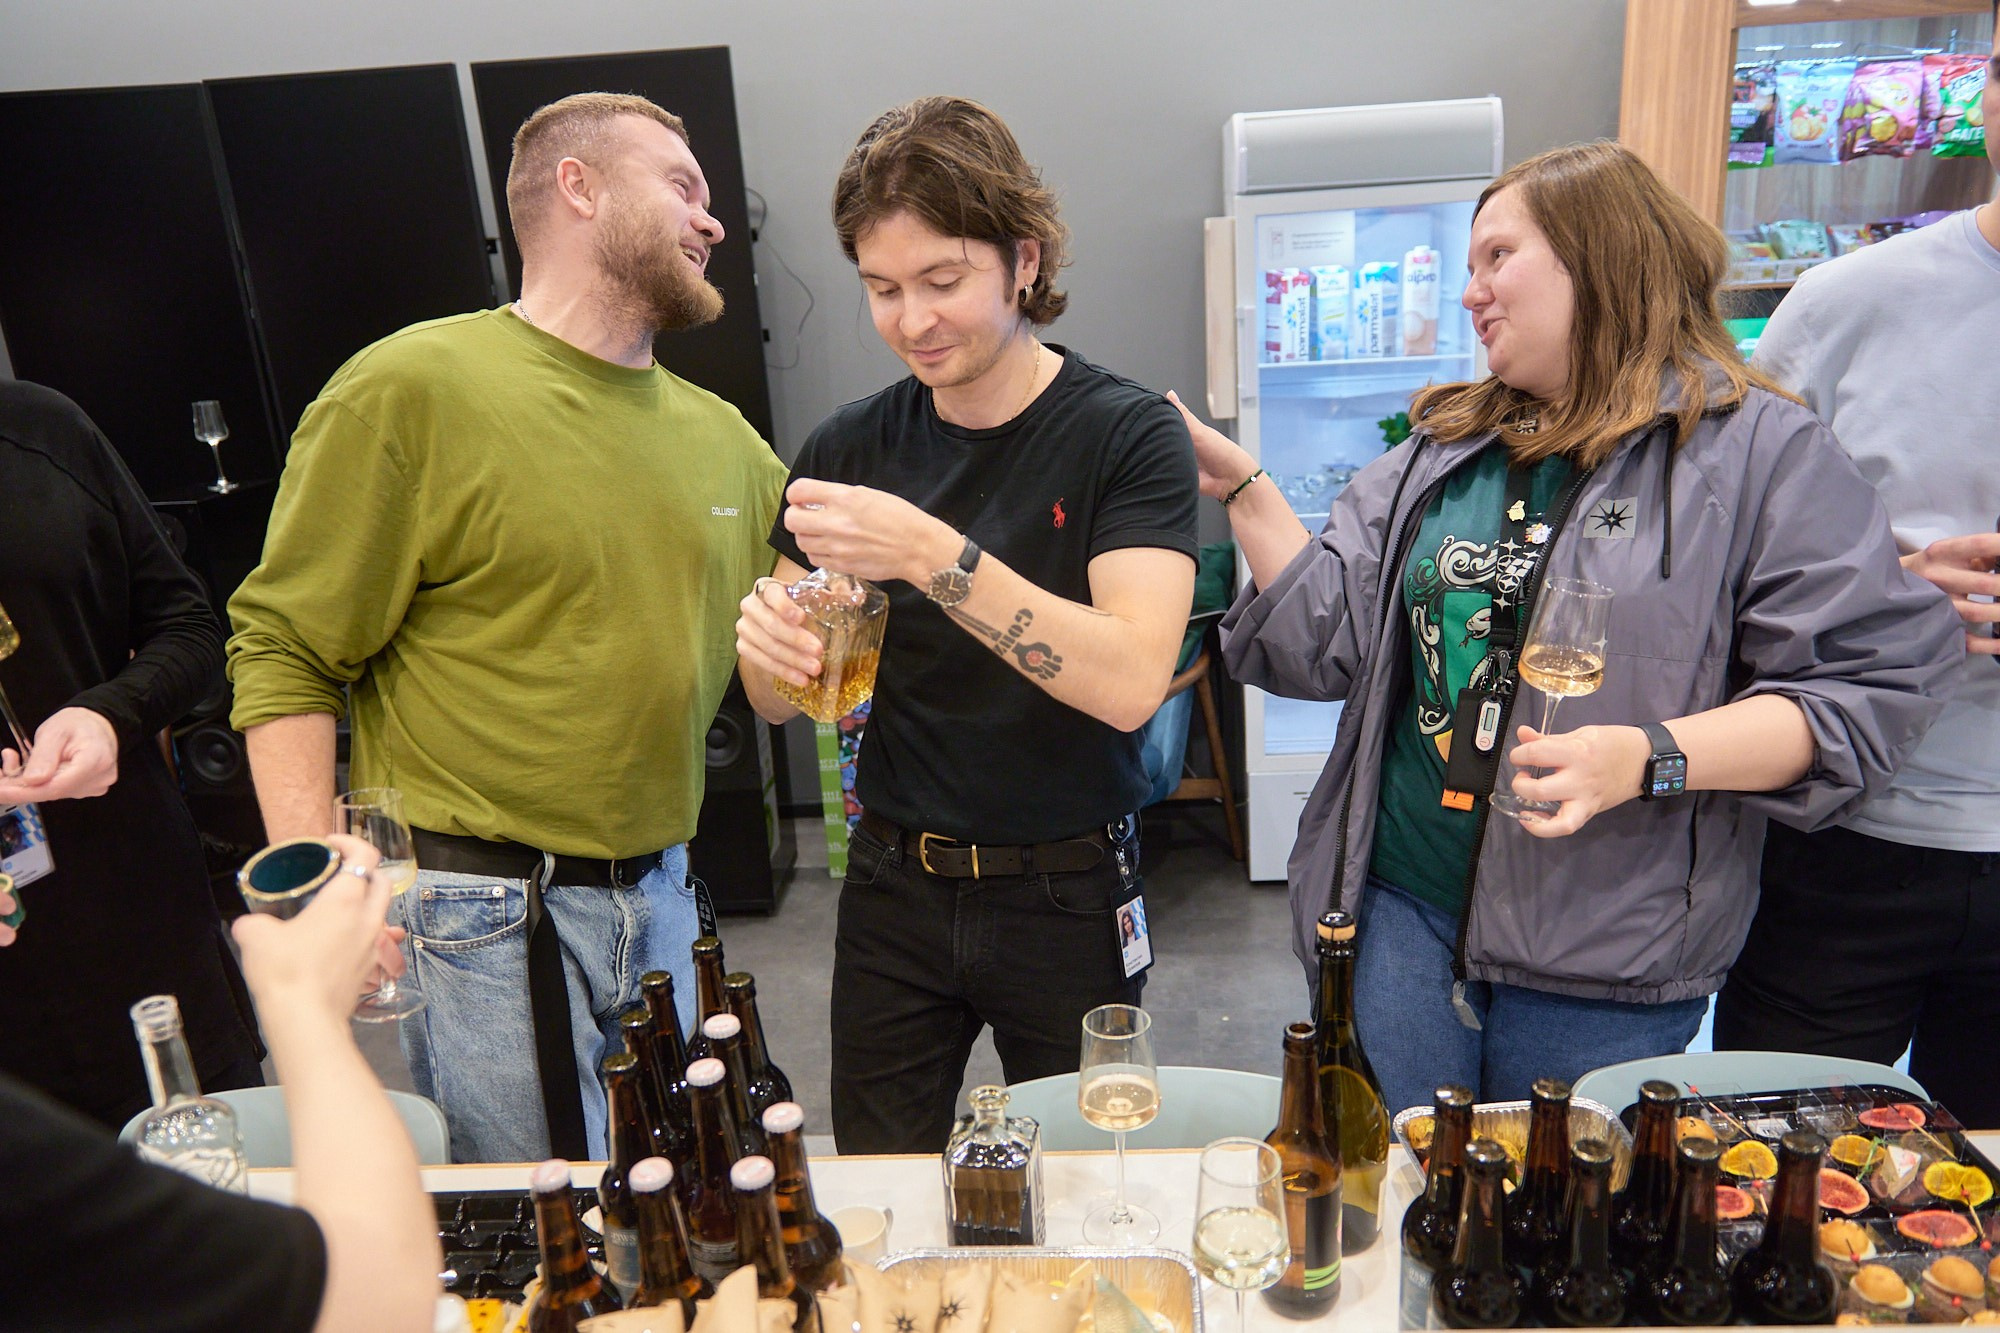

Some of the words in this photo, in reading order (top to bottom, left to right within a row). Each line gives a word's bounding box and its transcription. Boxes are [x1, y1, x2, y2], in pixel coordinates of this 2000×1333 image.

[1949, 126, 1985, 142] БАГЕ
[1407, 271, 1437, 284] alpro
[1370, 293, 1382, 354] parmalat
